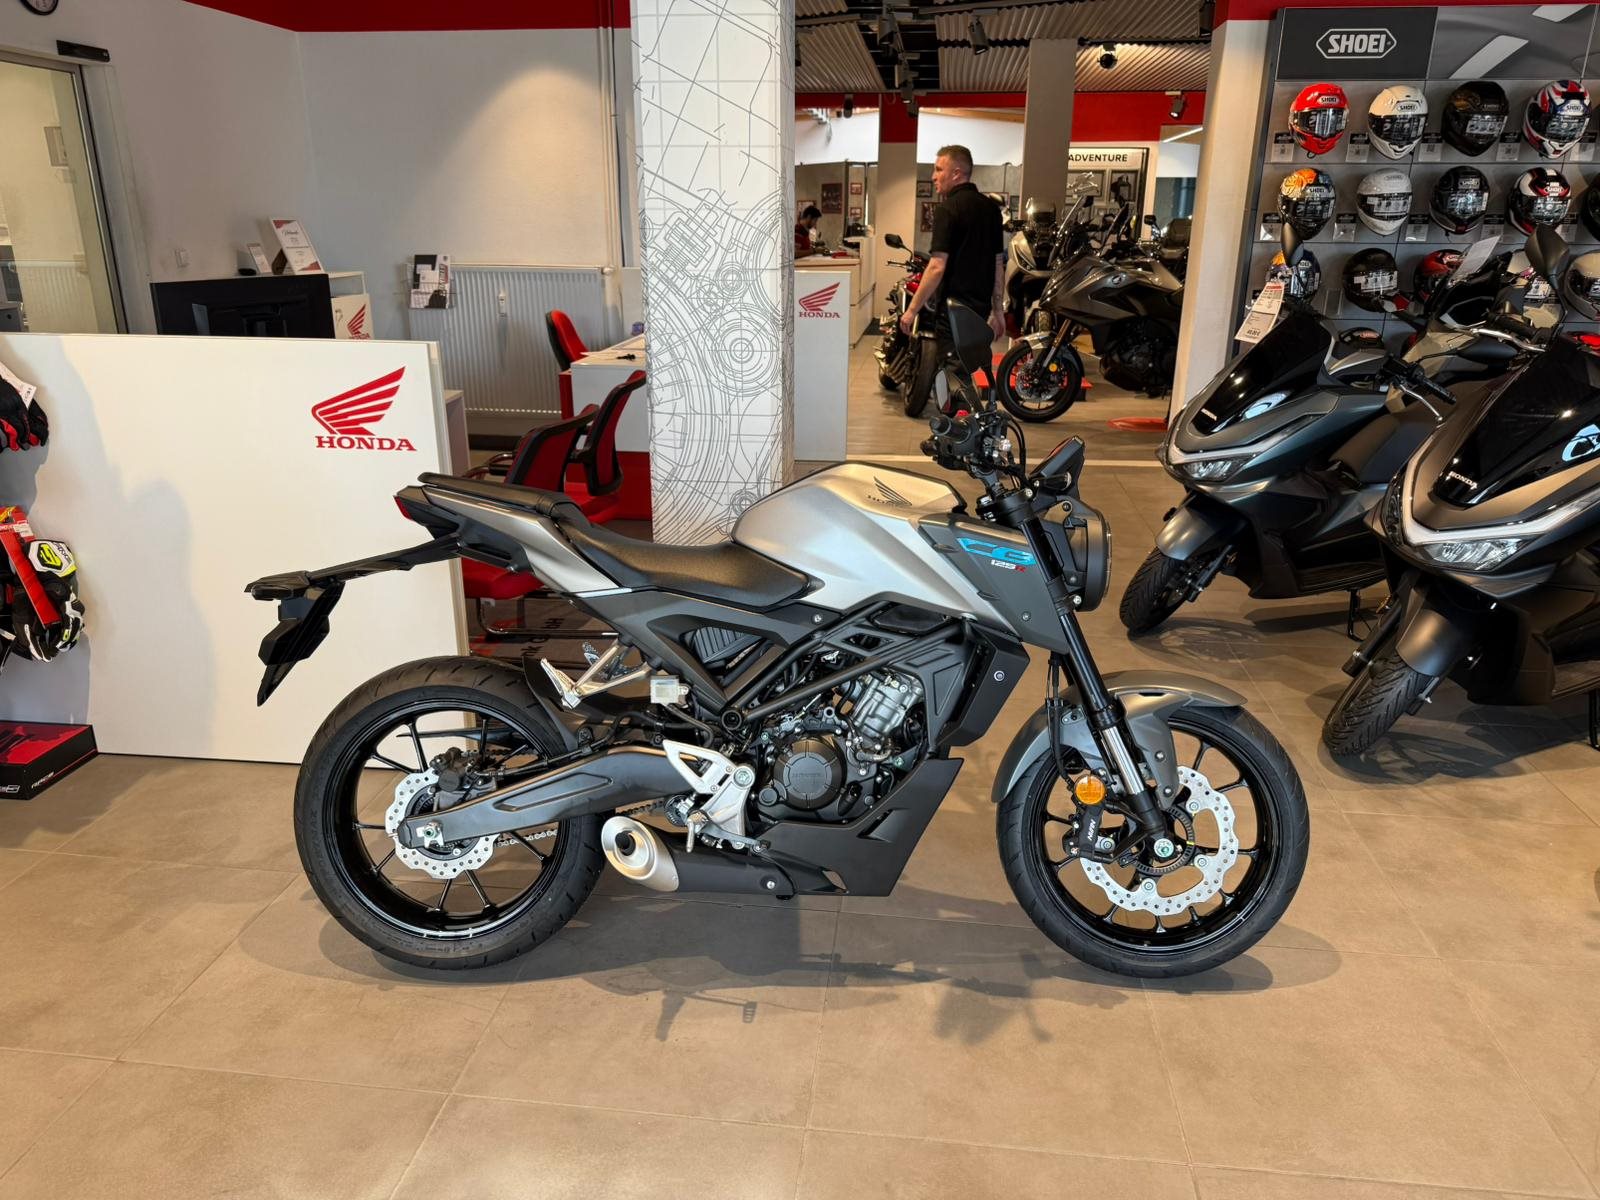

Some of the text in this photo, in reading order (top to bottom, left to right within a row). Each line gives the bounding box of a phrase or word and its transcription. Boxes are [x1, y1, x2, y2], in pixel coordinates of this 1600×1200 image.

[1327, 34, 1387, 54] SHOEI
[1068, 154, 1128, 162] ADVENTURE
[315, 435, 417, 451] HONDA
[1449, 471, 1478, 490] HONDA
[990, 559, 1026, 572] 125R
